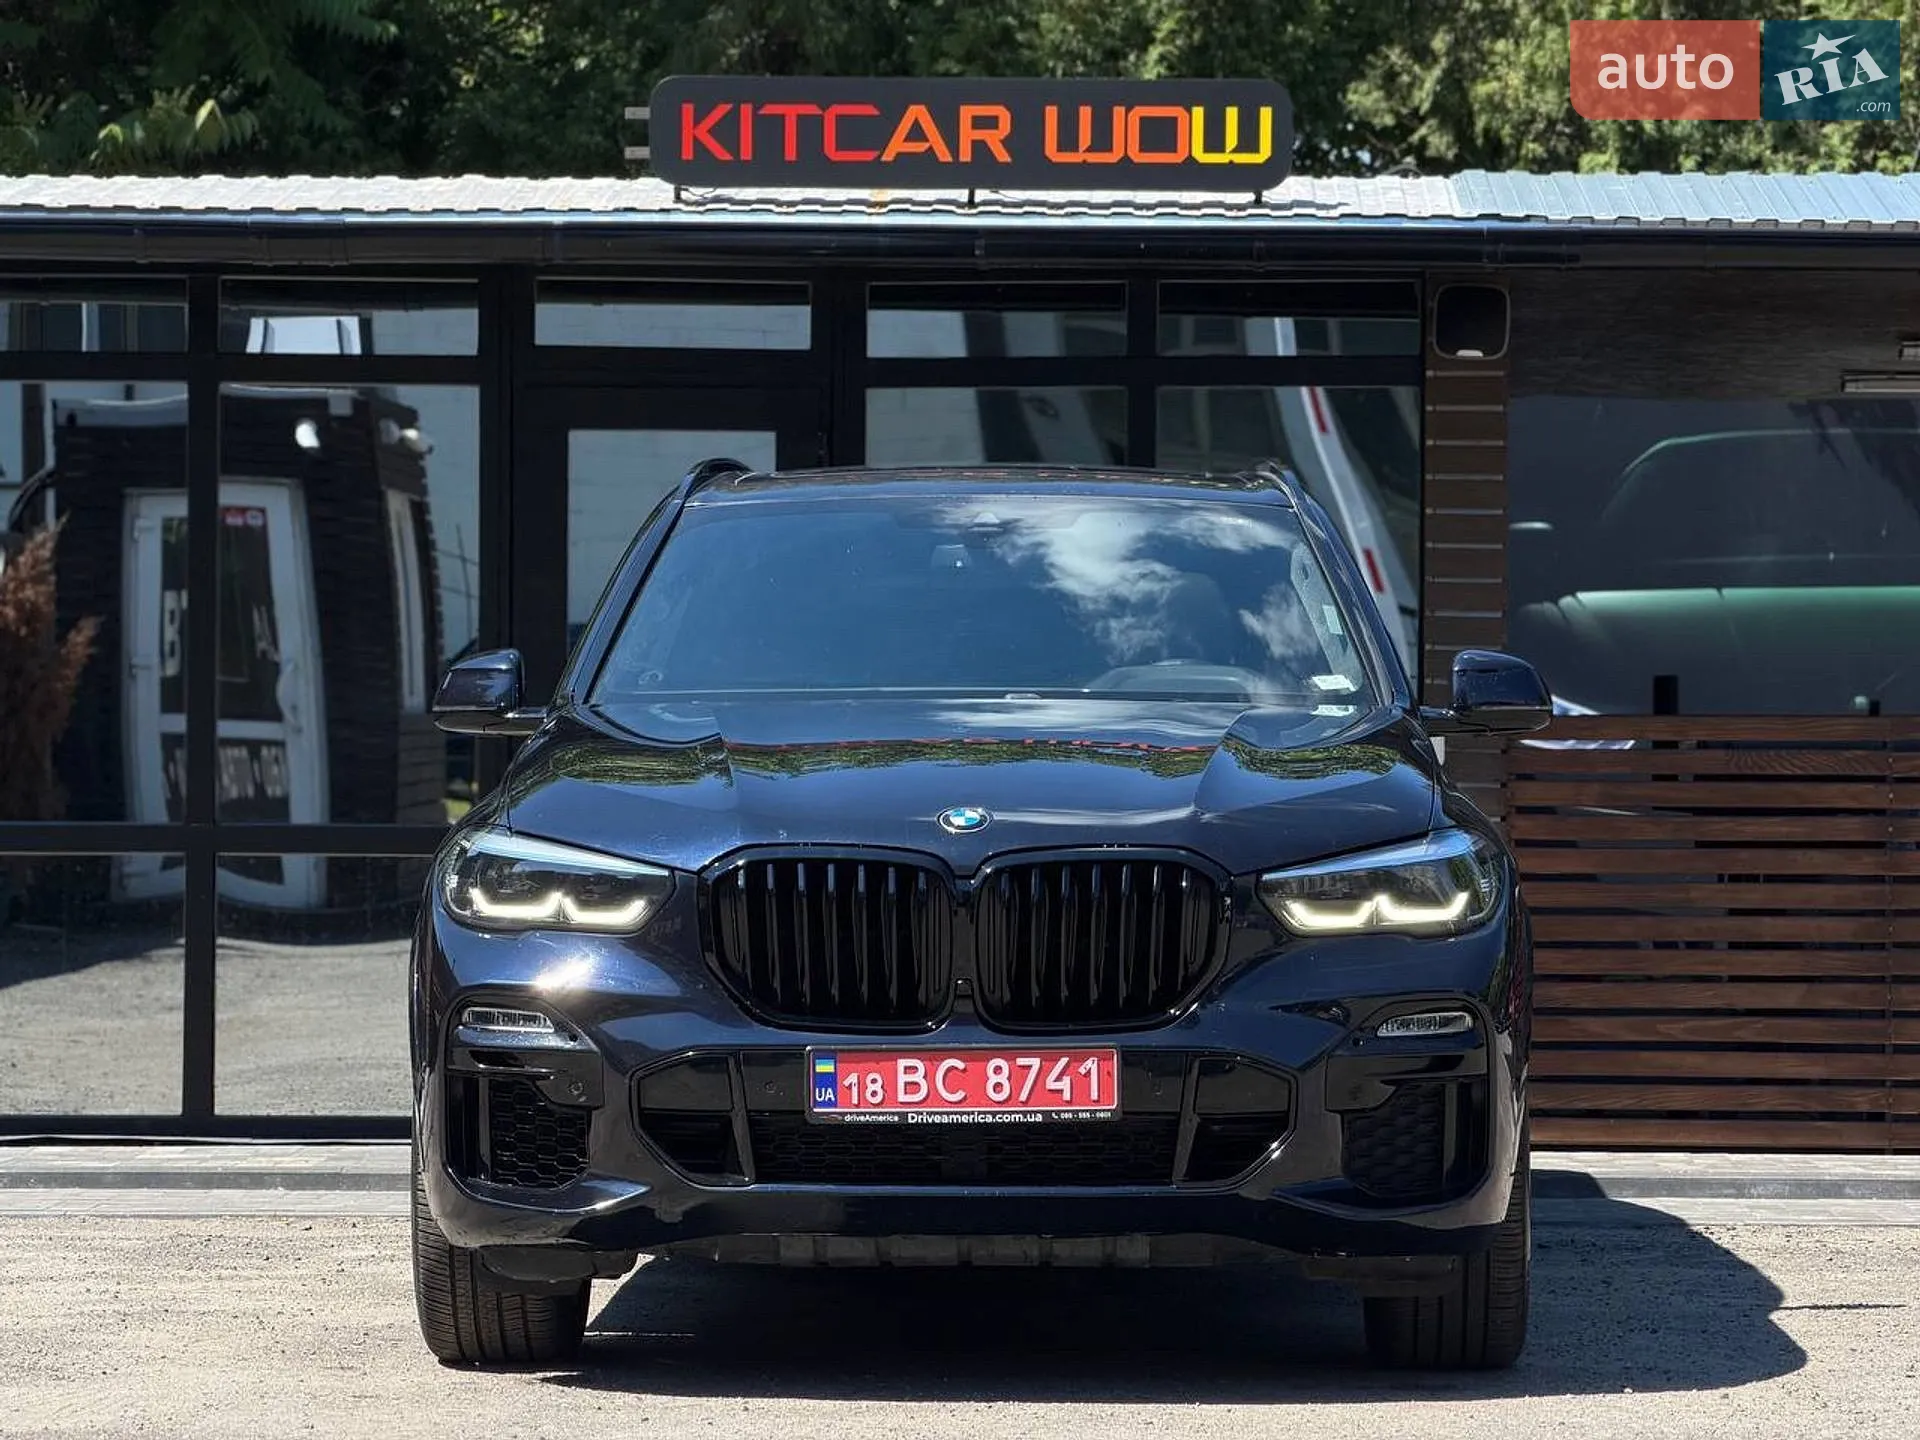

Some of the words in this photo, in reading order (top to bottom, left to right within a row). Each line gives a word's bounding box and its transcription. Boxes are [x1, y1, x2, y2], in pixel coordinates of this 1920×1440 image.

[680, 102, 1012, 163] KITCAR
[1043, 105, 1273, 164] WOW
[815, 1087, 835, 1102] UA
[843, 1072, 884, 1105] 18
[896, 1058, 967, 1103] BC
[985, 1056, 1099, 1103] 8741
[907, 1111, 1043, 1124] Driveamerica.com.ua
